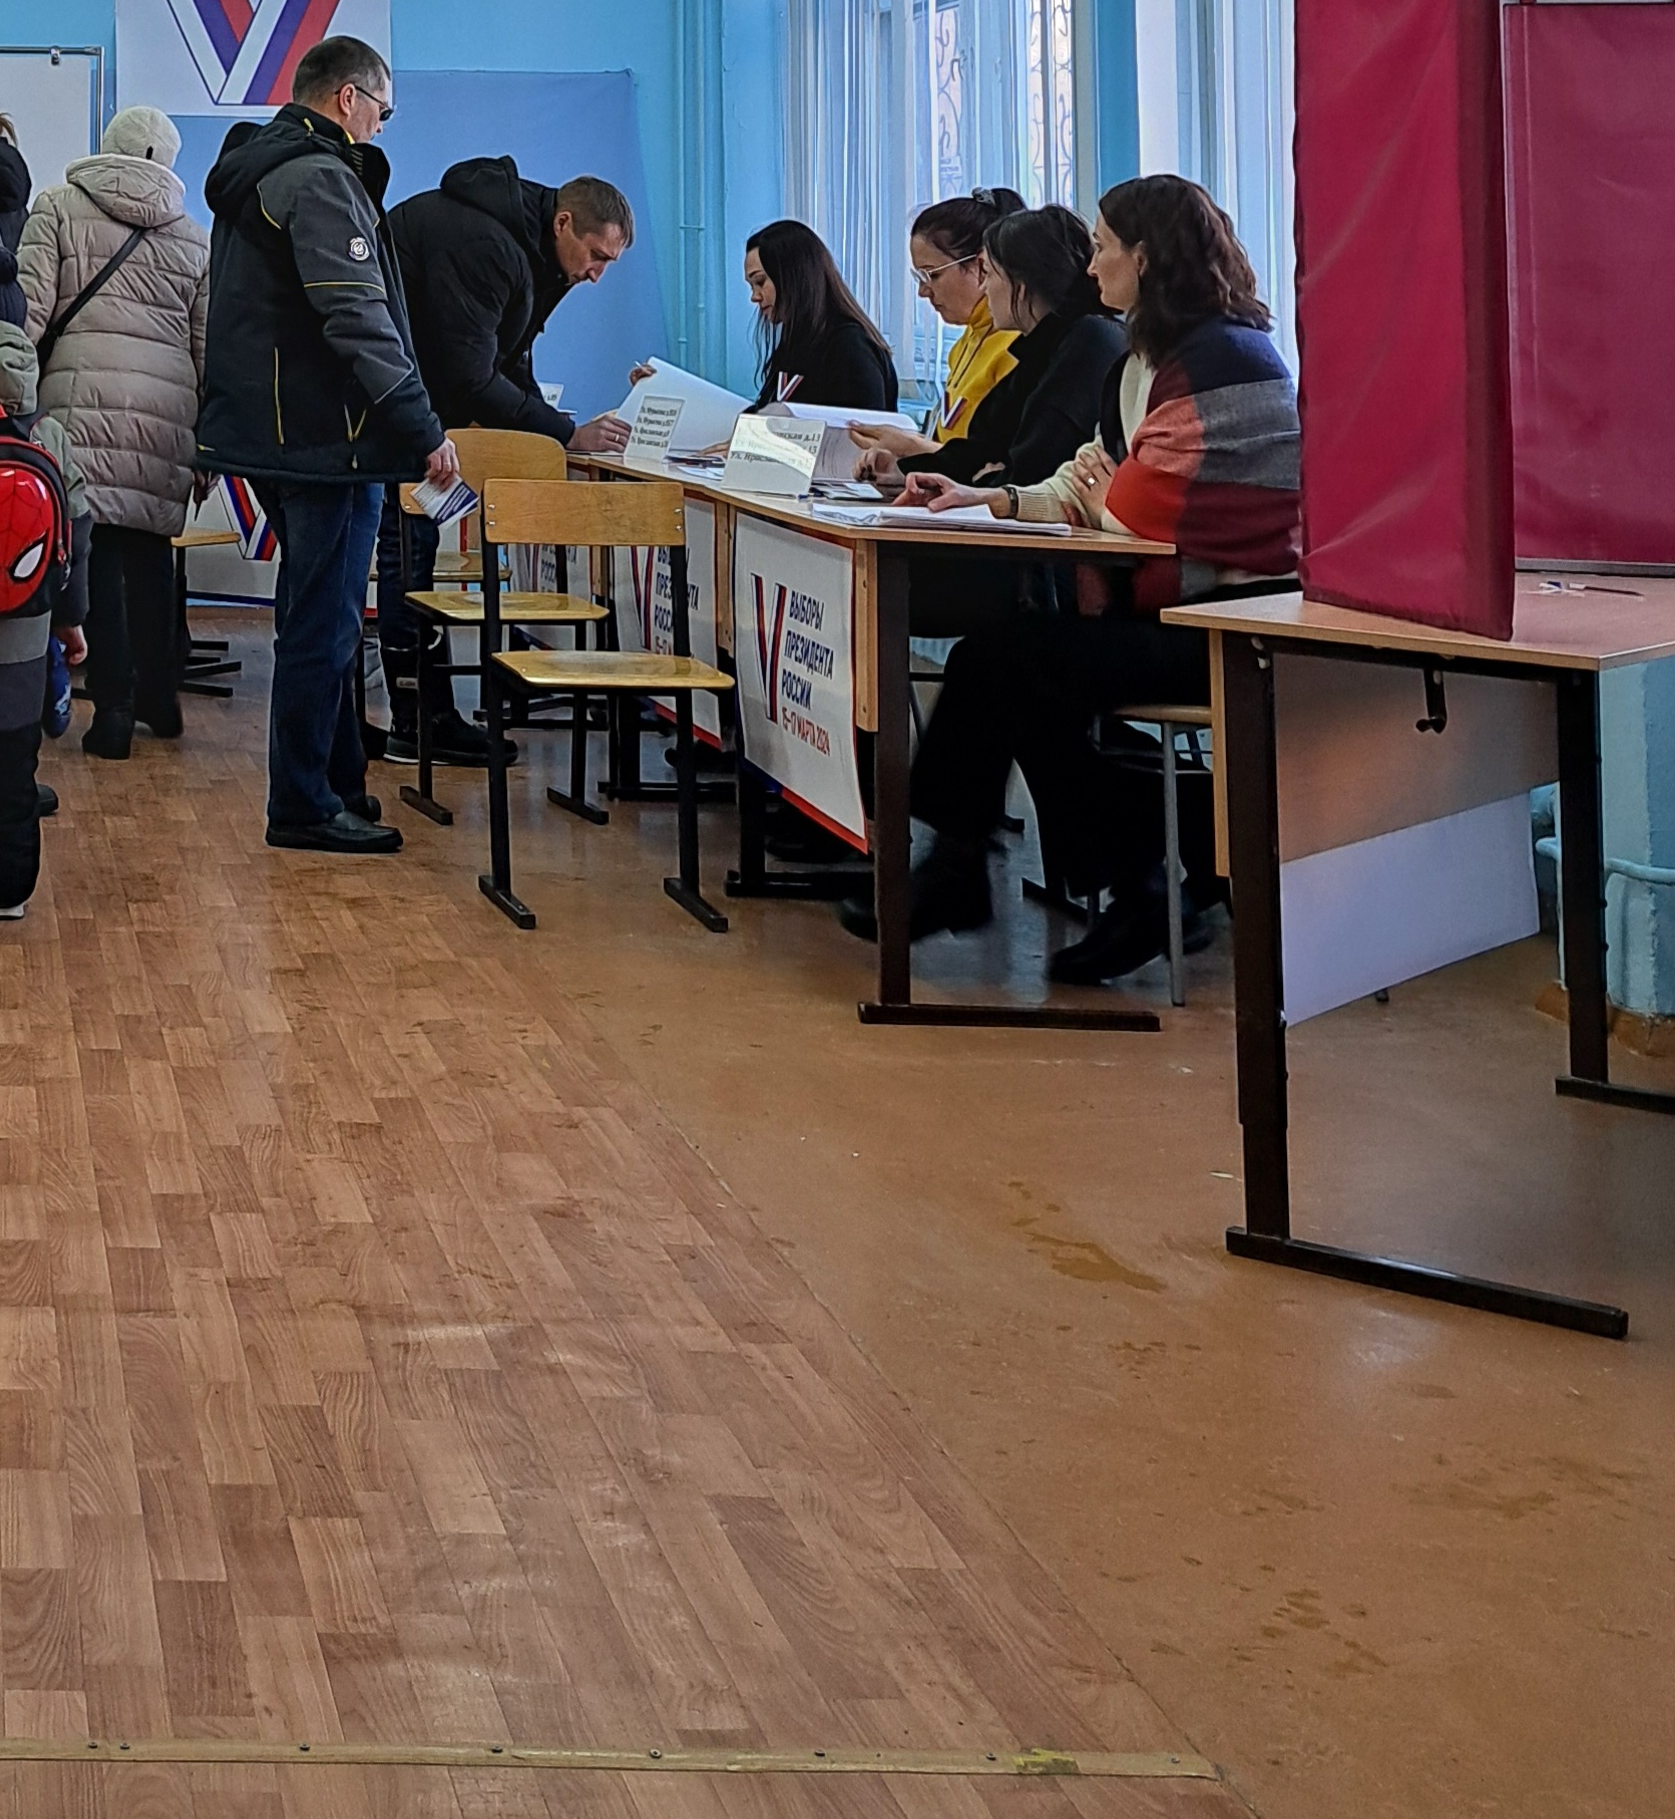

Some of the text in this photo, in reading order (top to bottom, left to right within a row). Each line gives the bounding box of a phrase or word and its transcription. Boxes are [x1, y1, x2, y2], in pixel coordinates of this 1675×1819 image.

[789, 590, 824, 631] ВЫБОРЫ
[784, 630, 834, 680] ПРЕЗИДЕНТА
[782, 668, 812, 710] РОССИИ
